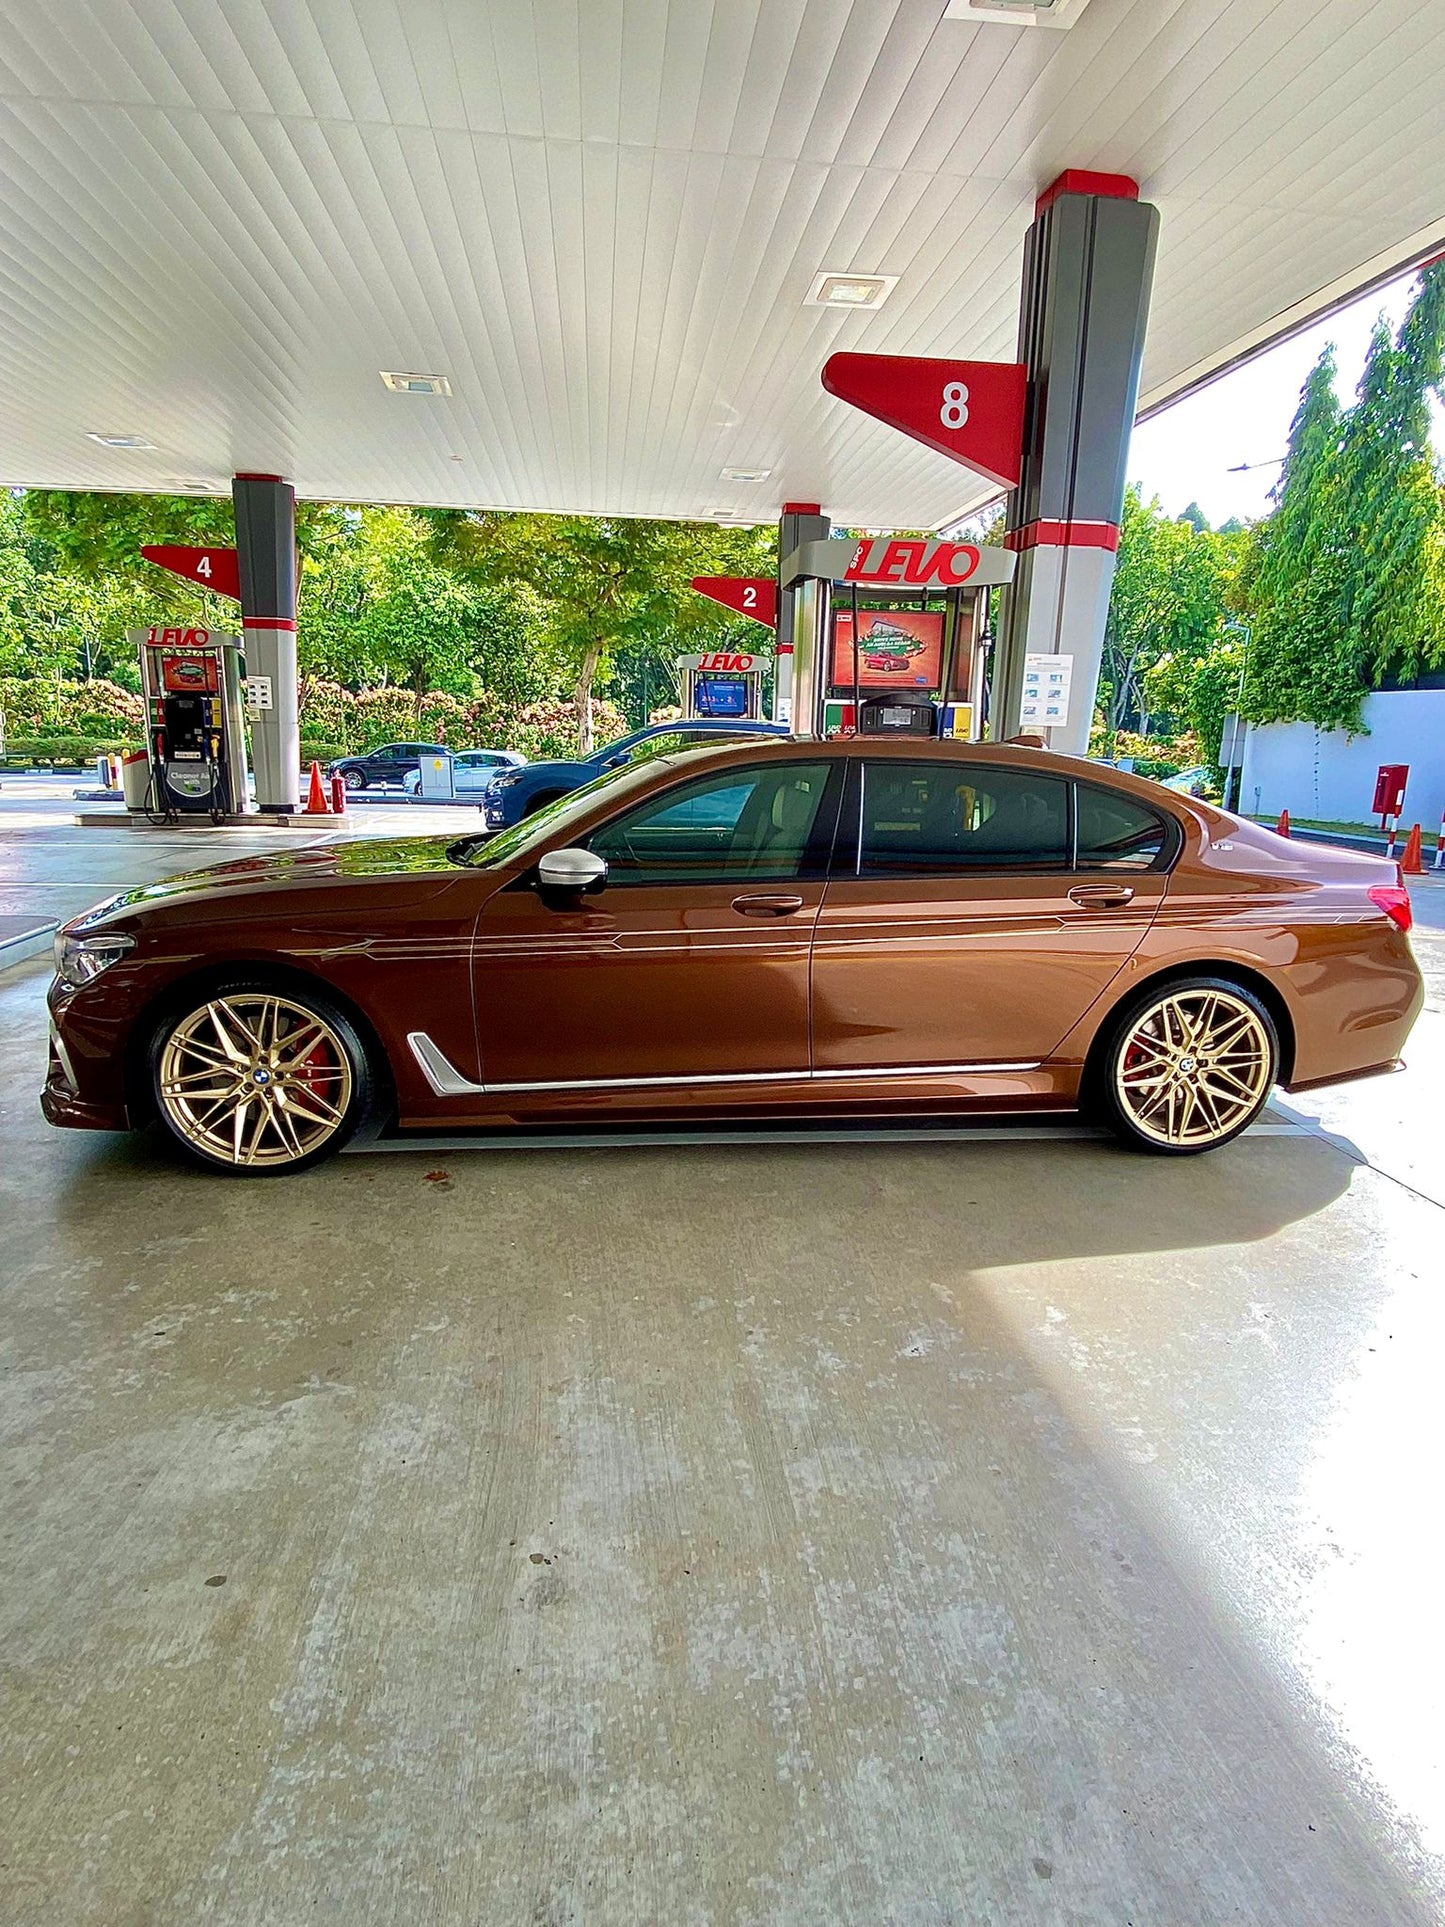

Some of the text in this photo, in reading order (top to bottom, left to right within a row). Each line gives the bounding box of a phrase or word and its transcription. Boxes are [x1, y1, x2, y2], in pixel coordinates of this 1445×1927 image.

[940, 381, 969, 430] 8
[195, 556, 212, 578] 4
[843, 539, 981, 585] LEVO
[849, 545, 864, 570] SPC
[743, 587, 757, 608] 2
[147, 627, 209, 647] LEVO
[697, 653, 753, 672] LEVO
